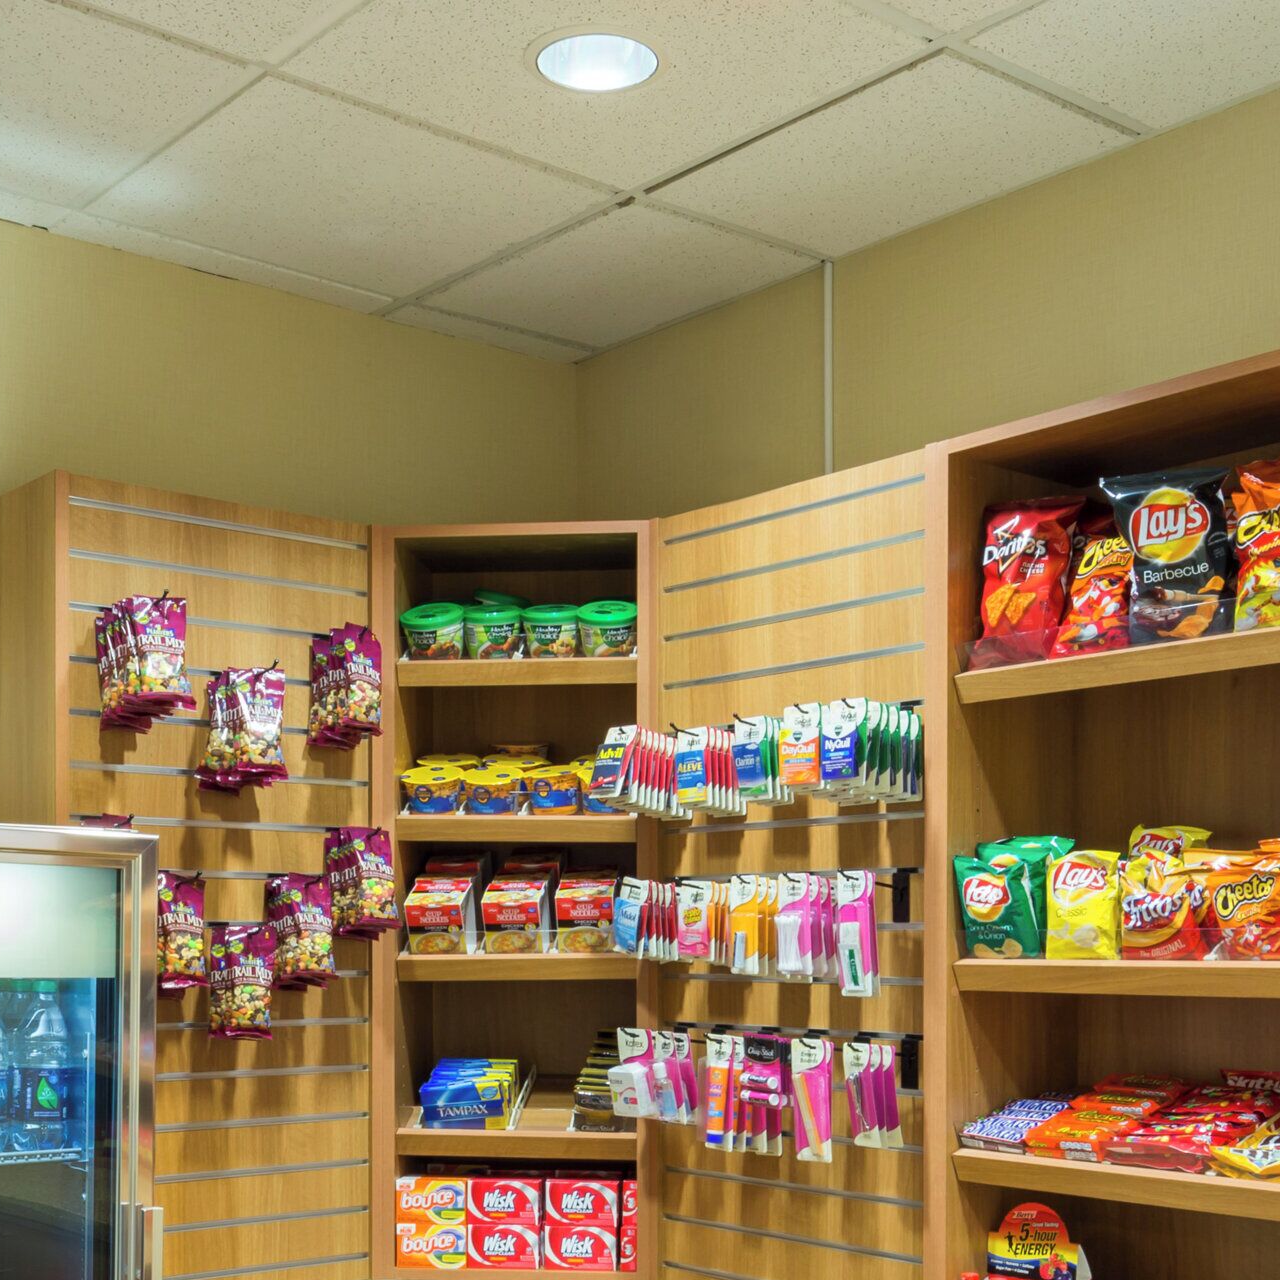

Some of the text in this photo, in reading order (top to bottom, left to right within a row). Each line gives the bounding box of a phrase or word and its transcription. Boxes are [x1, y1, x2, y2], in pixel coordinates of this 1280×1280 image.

[1138, 501, 1203, 548] Lay's
[983, 528, 1047, 566] Doritos
[1143, 562, 1210, 585] Barbecue
[137, 635, 185, 649] TRAIL MIX
[347, 663, 381, 683] TRAIL MIX
[599, 747, 623, 759] Advil
[781, 745, 815, 756] DayQuil
[824, 739, 851, 751] NyQuil
[1053, 861, 1107, 890] Lay's
[1216, 873, 1276, 919] Cheetos
[570, 909, 600, 917] NOODLES
[620, 909, 638, 922] Midol
[1122, 889, 1185, 930] Fritos
[163, 914, 188, 926] TRAIL
[316, 914, 332, 926] MIX
[1151, 940, 1185, 957] ORIGINAL
[235, 966, 273, 981] TRAIL MIX
[436, 1103, 489, 1118] TAMPAX
[401, 1189, 454, 1210] bounce
[483, 1189, 517, 1209] Wisk
[562, 1191, 595, 1210] Wisk
[1019, 1222, 1058, 1242] 5-hour
[401, 1233, 457, 1254] bounce
[482, 1232, 517, 1251] Wisk
[560, 1235, 593, 1253] Wisk
[1014, 1242, 1056, 1257] ENERGY
